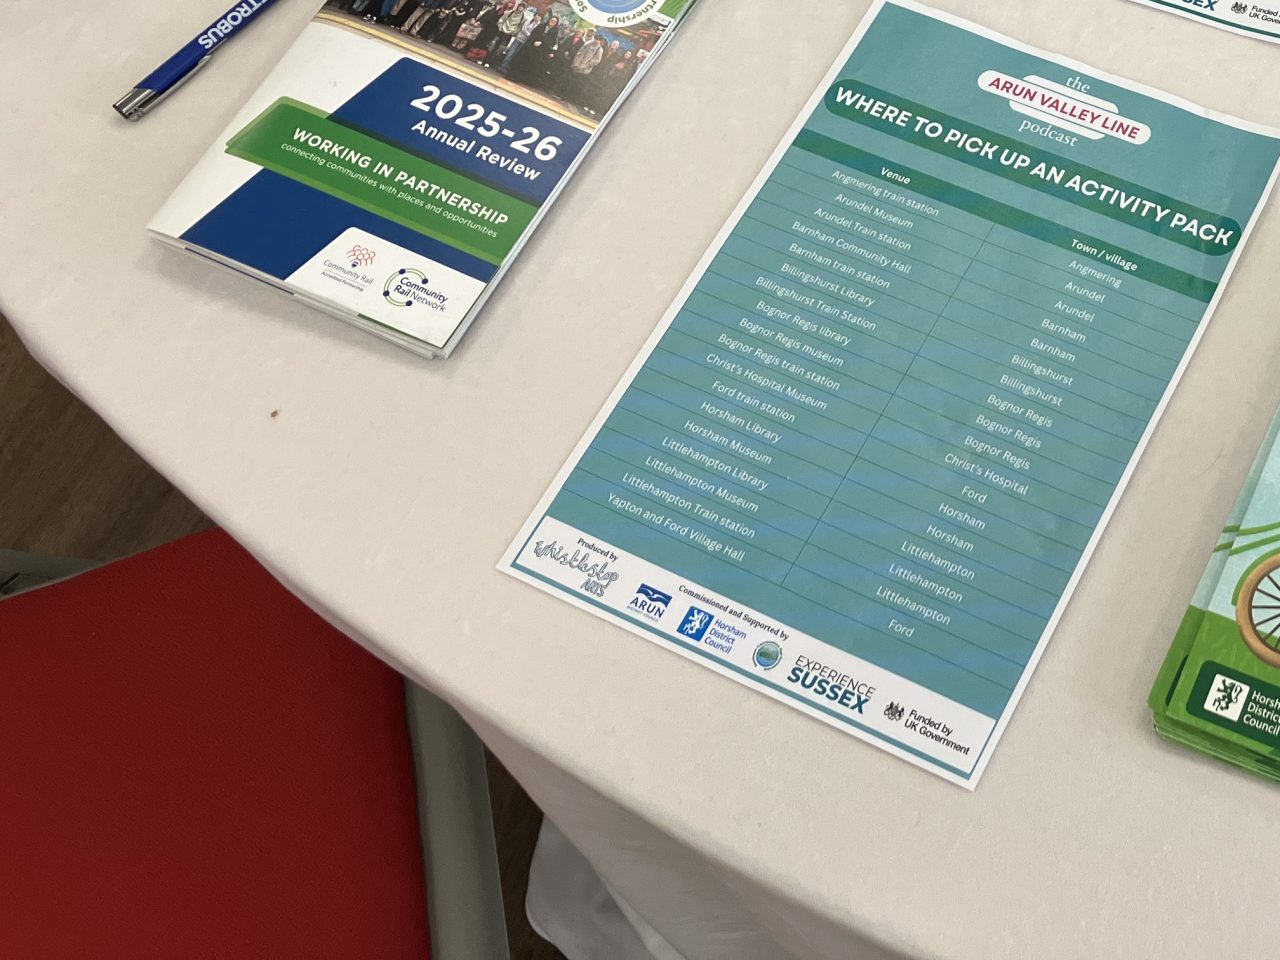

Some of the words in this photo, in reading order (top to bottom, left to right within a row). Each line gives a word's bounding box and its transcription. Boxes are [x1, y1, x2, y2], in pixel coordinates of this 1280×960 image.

[408, 84, 563, 161] 2025-26
[411, 120, 476, 153] Annual
[476, 145, 541, 180] Review
[293, 127, 372, 168] WORKING
[373, 162, 394, 178] IN
[394, 171, 508, 224] PARTNERSHIP
[832, 171, 882, 197] Angmering
[883, 190, 905, 204] train
[906, 199, 939, 216] station
[836, 86, 912, 127] WHERE
[914, 116, 943, 138] TO
[944, 128, 999, 160] PICK
[1000, 148, 1031, 169] UP
[1029, 162, 1066, 184] AN
[1064, 175, 1171, 222] ACTIVITY
[1170, 213, 1233, 246] PACK
[881, 167, 910, 184] Venue
[1072, 238, 1098, 256] Town
[1106, 253, 1138, 271] village
[608, 493, 643, 516] Yapton
[643, 511, 664, 524] and
[663, 518, 690, 536] Ford
[688, 529, 722, 551] Village
[723, 545, 745, 562] Hall
[876, 586, 950, 625] Littlehampton
